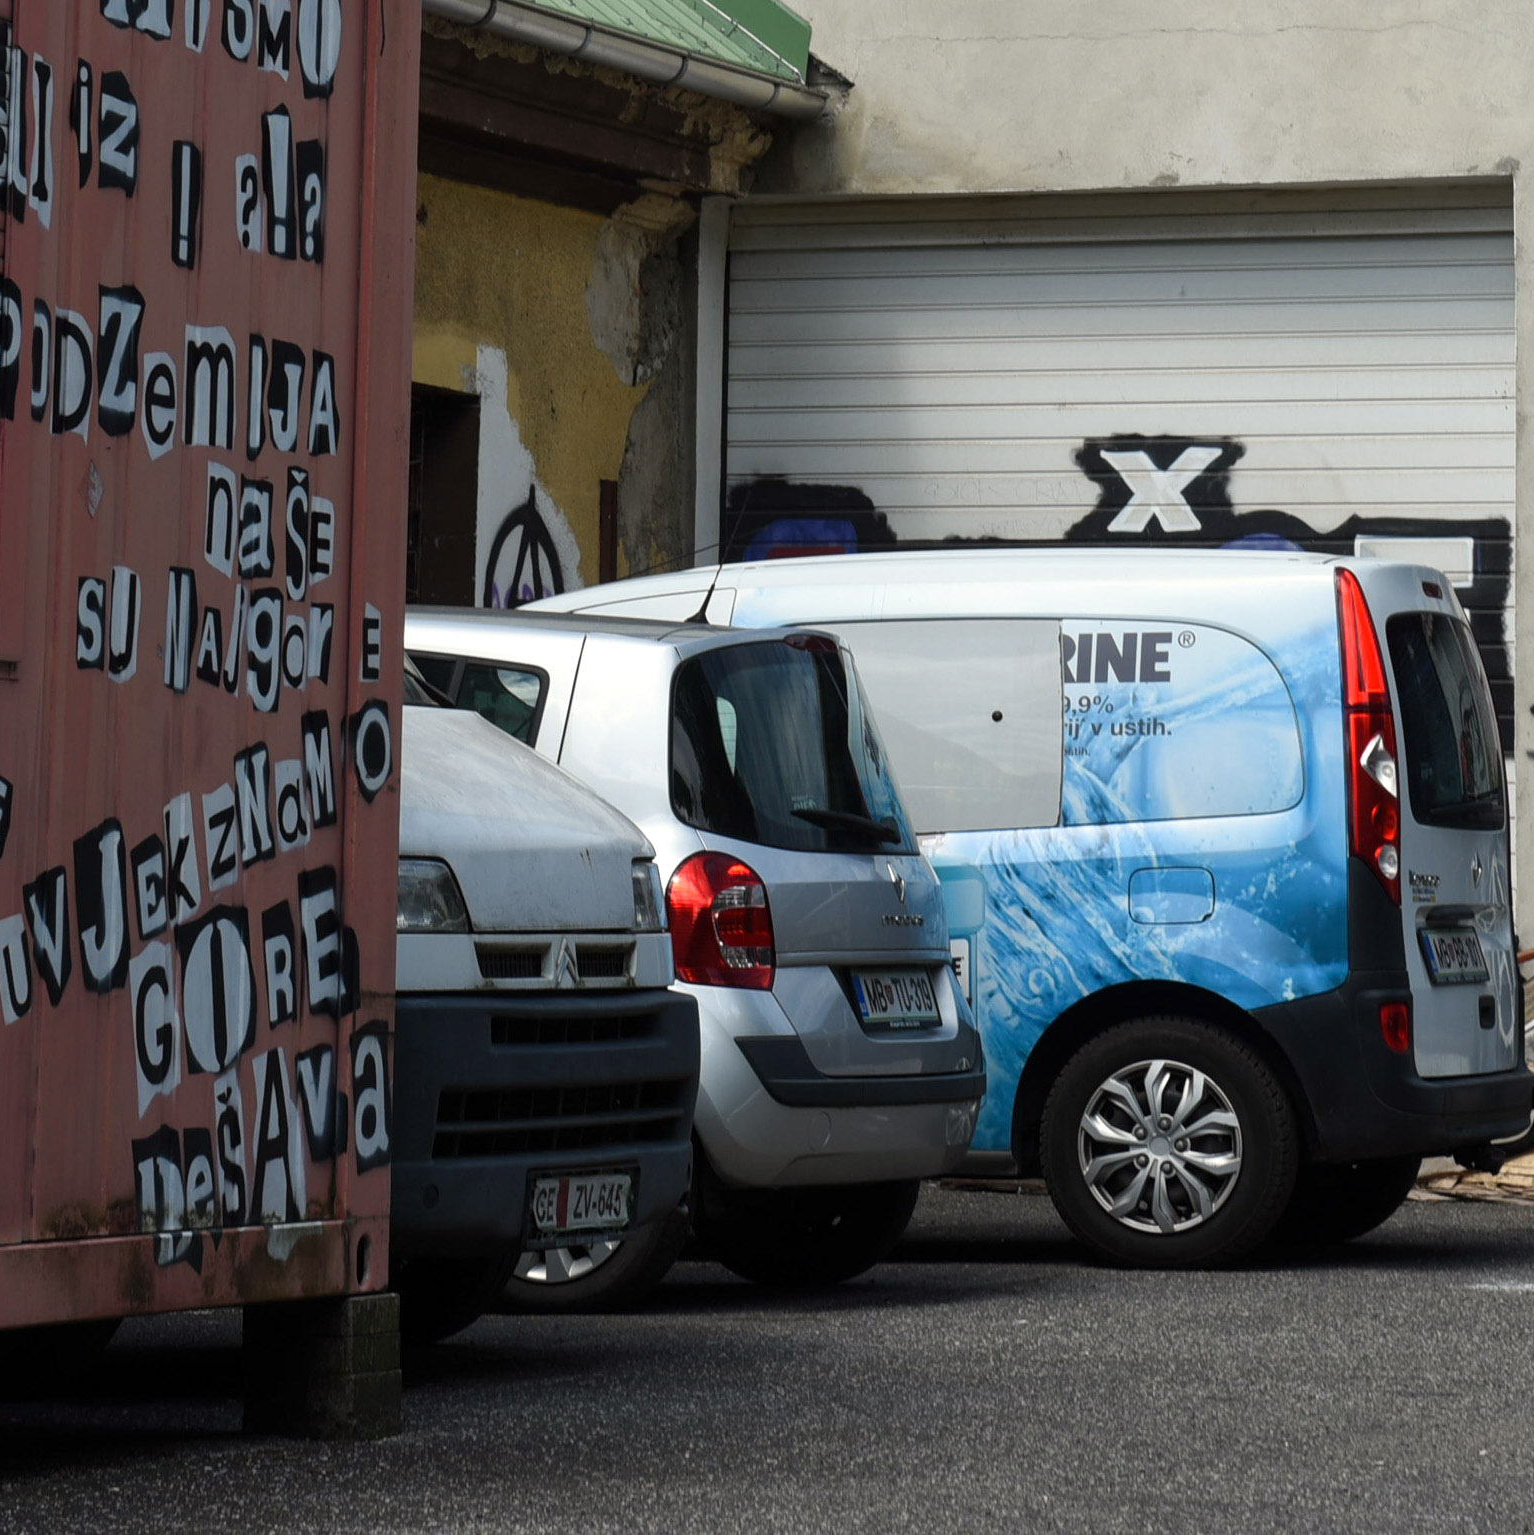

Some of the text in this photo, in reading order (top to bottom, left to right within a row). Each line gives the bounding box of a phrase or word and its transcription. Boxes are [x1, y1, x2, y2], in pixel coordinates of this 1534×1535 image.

[78, 64, 138, 180] iz
[77, 567, 137, 676] SU
[1110, 718, 1172, 736] ustih.
[2, 807, 198, 1018] UVJEK
[135, 889, 349, 1086] GORE
[572, 1183, 623, 1220] ZV-645
